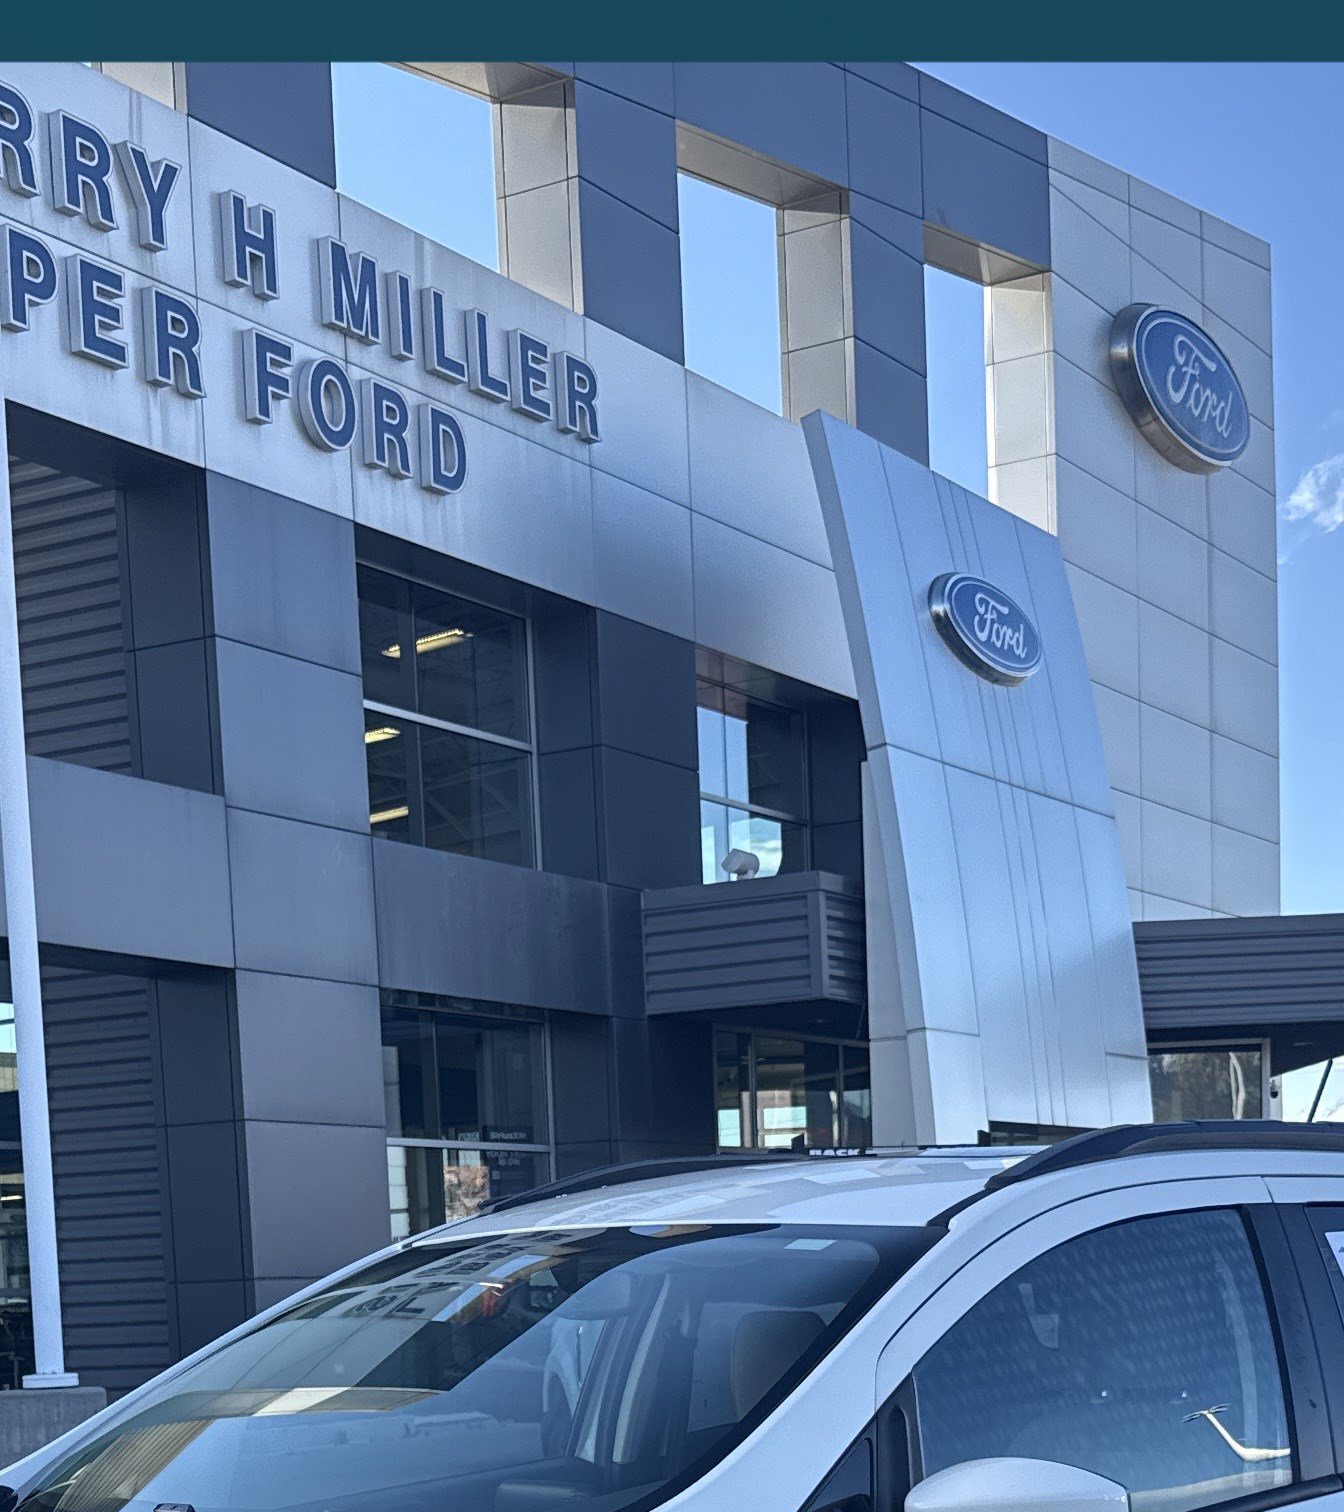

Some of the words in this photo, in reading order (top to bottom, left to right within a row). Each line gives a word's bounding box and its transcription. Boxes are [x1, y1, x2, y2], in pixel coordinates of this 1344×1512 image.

[222, 189, 280, 300] H
[317, 236, 602, 443] MILLER
[243, 327, 469, 495] FORD
[1166, 335, 1233, 440] Ford
[974, 593, 1027, 659] Ford
